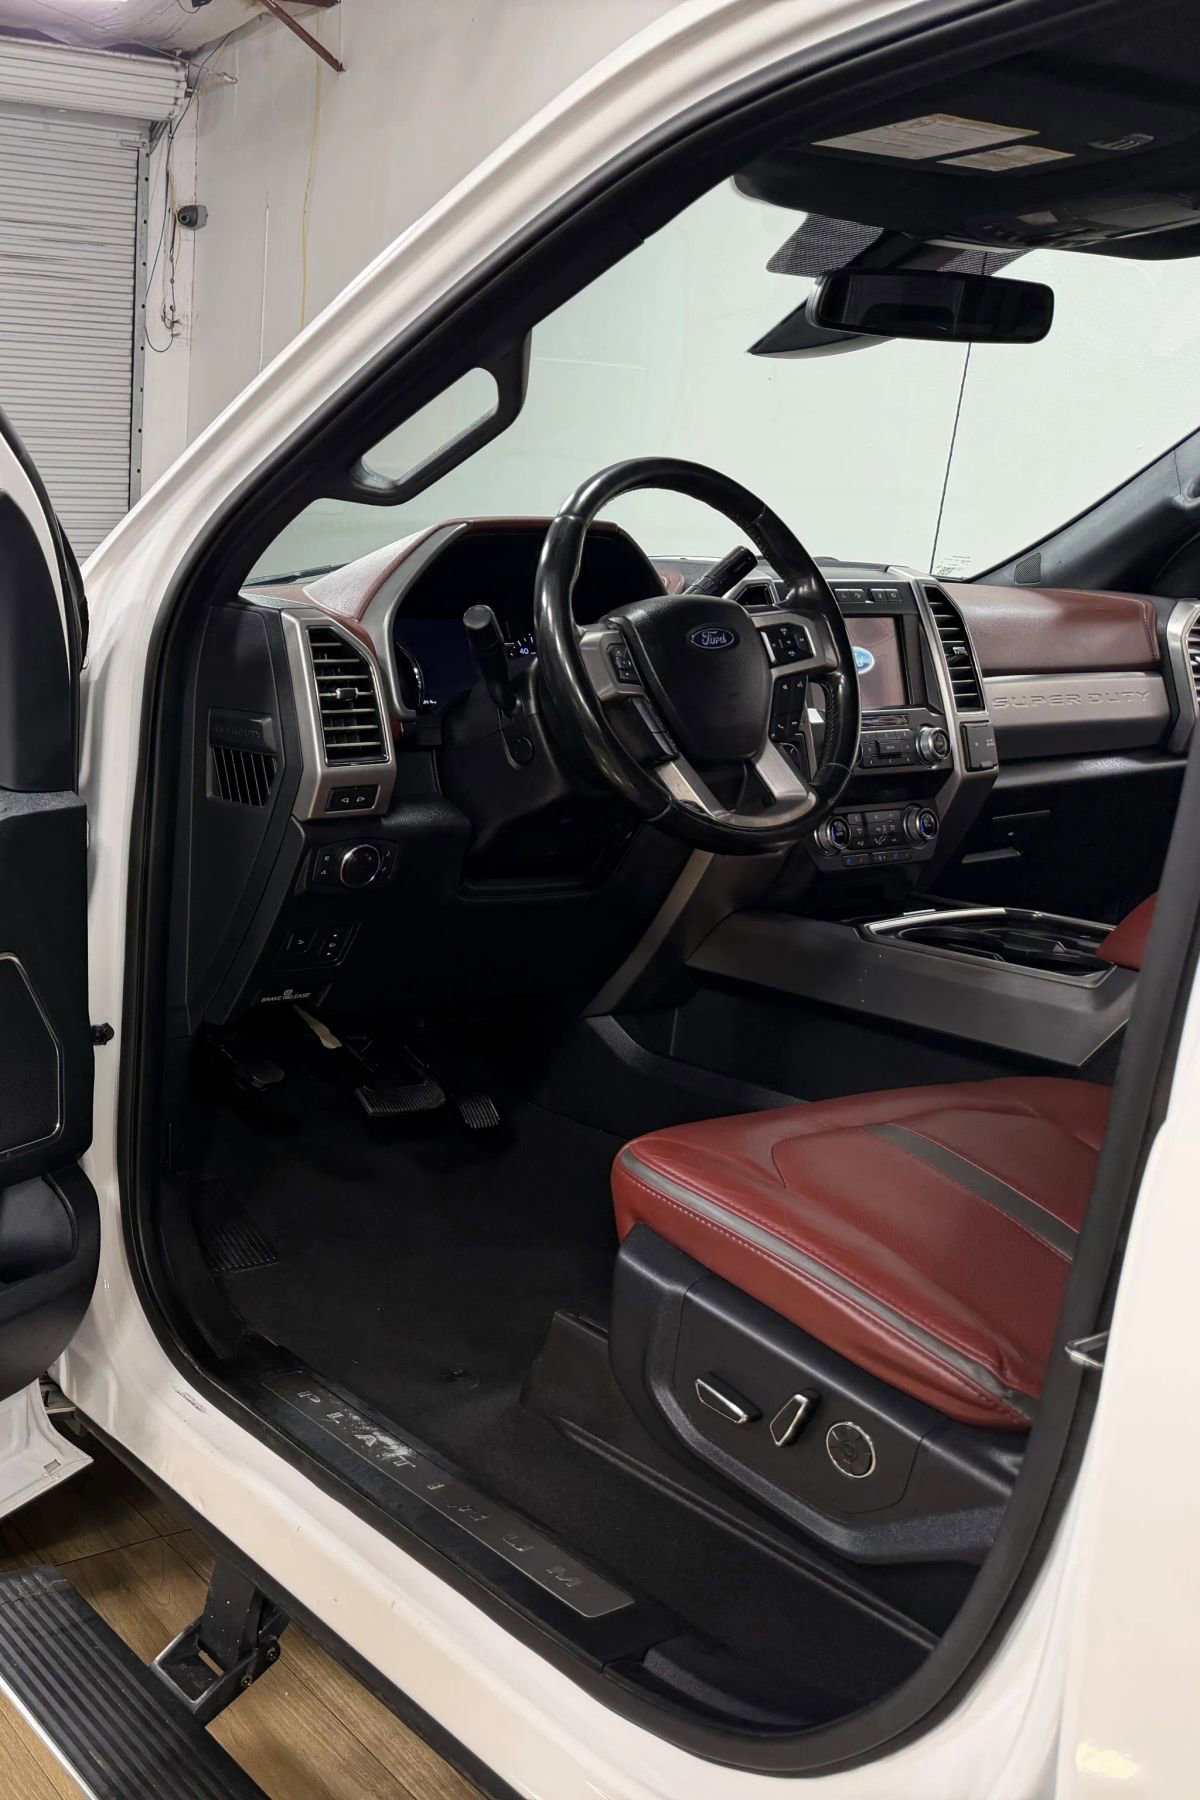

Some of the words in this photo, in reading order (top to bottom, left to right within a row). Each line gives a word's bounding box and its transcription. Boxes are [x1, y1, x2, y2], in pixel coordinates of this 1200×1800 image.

[701, 630, 727, 645] Ford
[519, 647, 530, 655] 40
[992, 693, 1082, 709] SUPER
[1087, 690, 1149, 704] DUTY
[260, 995, 282, 1003] BRAKE
[282, 992, 311, 1000] RELEASE
